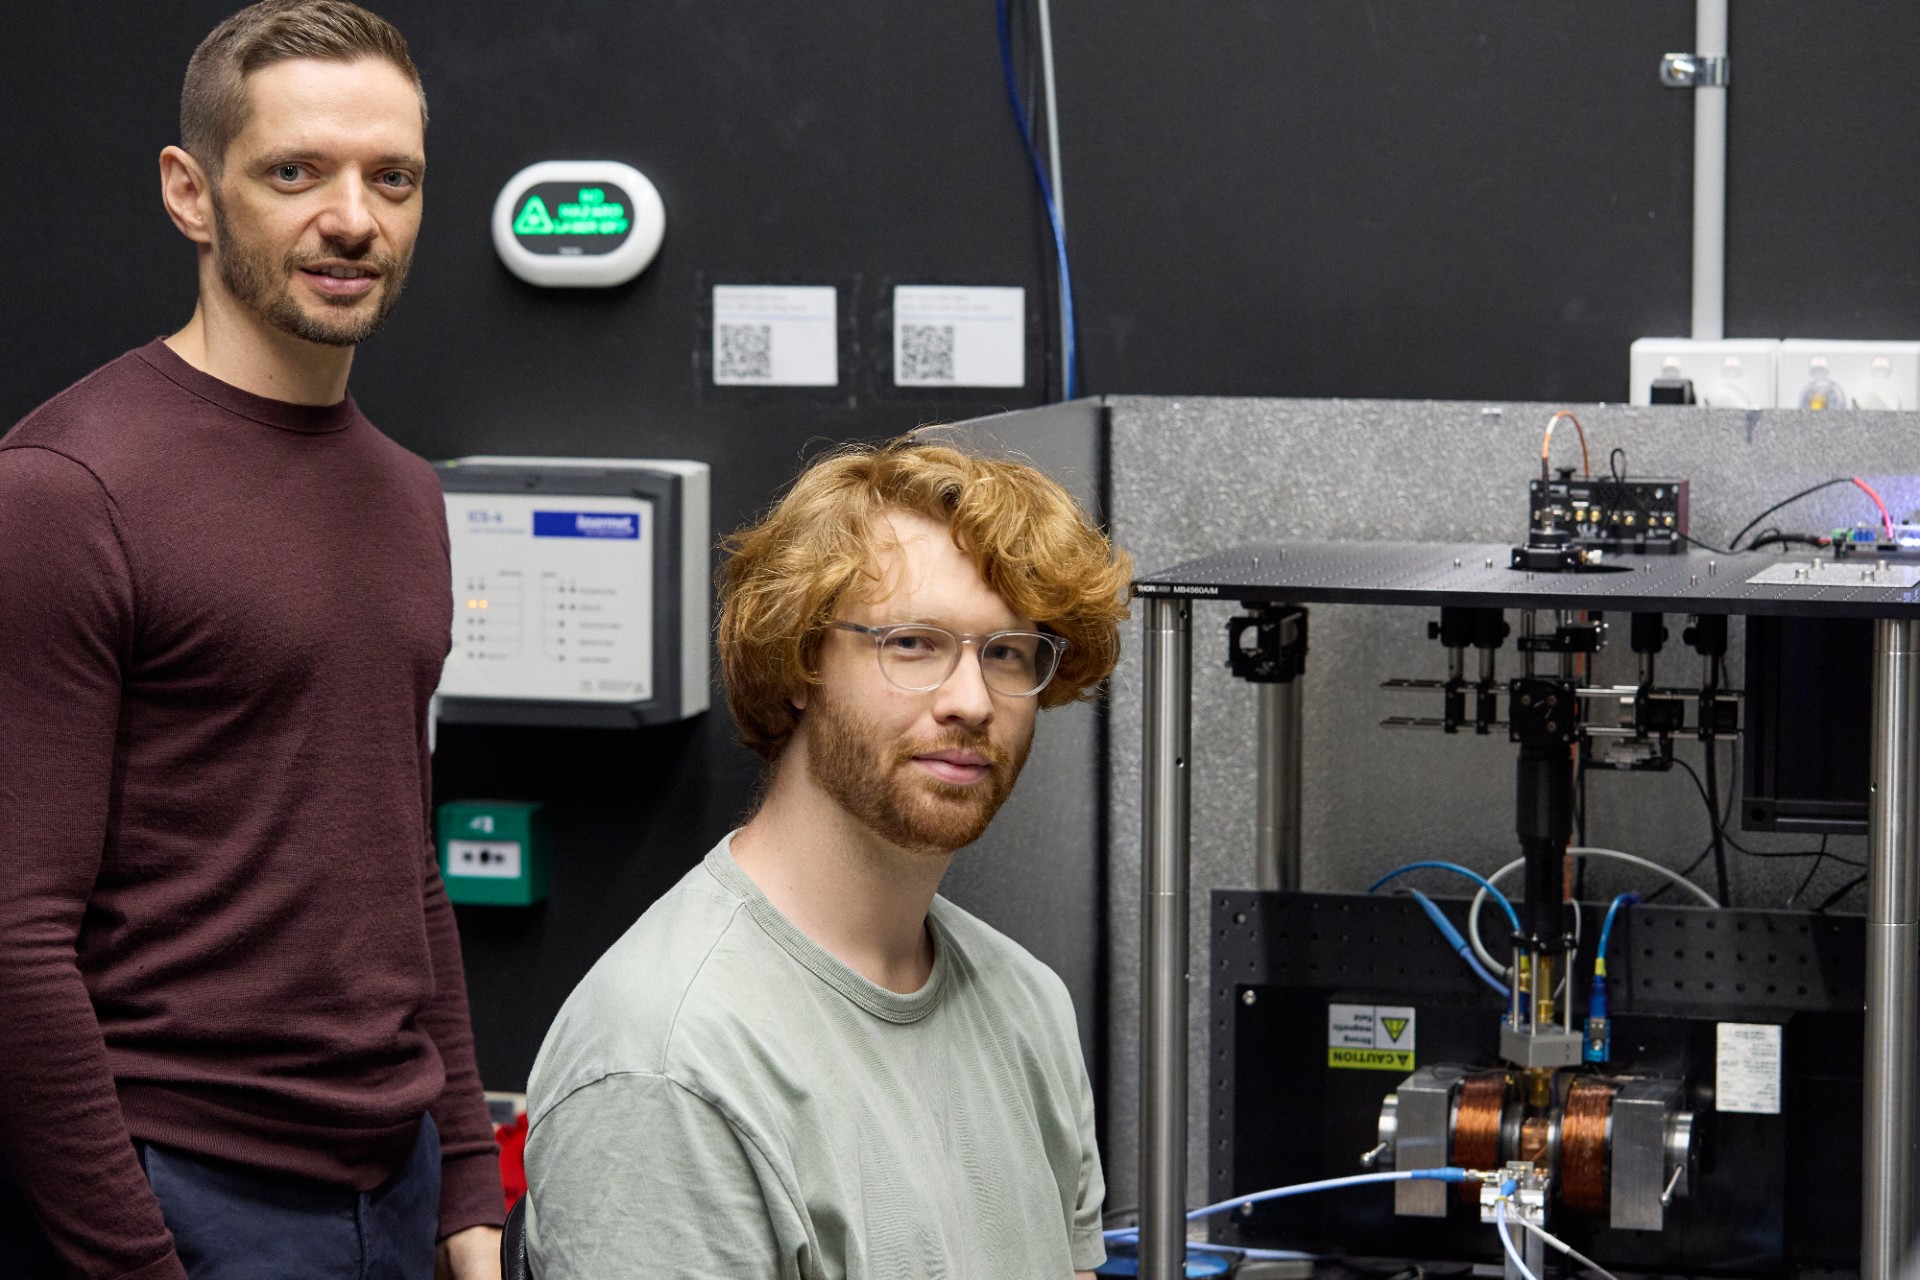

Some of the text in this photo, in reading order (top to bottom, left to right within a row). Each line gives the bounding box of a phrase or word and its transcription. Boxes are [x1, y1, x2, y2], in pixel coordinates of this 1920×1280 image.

[1333, 1023, 1372, 1033] magnetic
[1343, 1035, 1372, 1045] Strong
[1333, 1051, 1394, 1065] CAUTION
